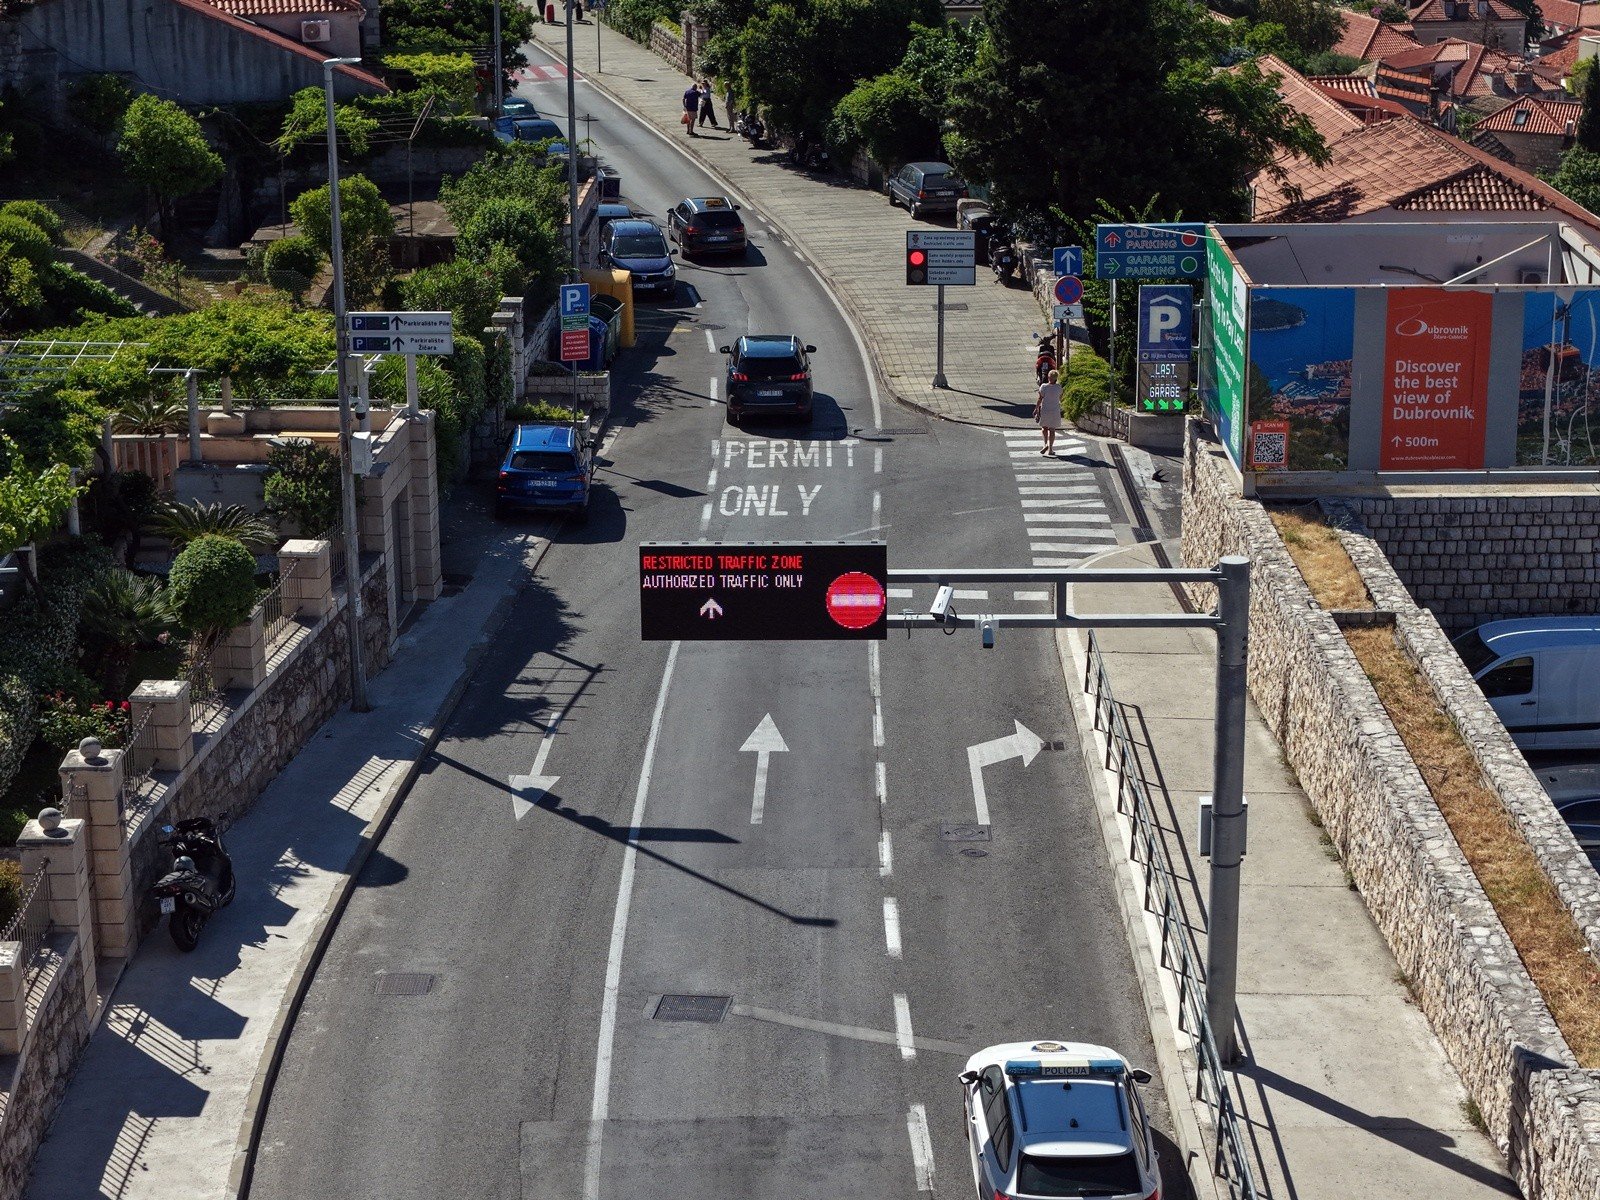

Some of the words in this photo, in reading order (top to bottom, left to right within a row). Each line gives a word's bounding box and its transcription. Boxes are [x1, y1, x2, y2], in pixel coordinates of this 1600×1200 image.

[1125, 229, 1149, 238] OLD
[1151, 228, 1179, 238] CITY
[1126, 240, 1178, 249] PARKING
[1126, 255, 1176, 265] GARAGE
[1125, 266, 1177, 276] PARKING
[567, 289, 581, 312] P
[1148, 305, 1182, 344] P
[1155, 363, 1176, 375] LAST
[1395, 360, 1462, 373] Discover
[1394, 375, 1420, 389] the
[1425, 375, 1459, 389] best
[1149, 386, 1180, 398] GARAGE
[1393, 391, 1430, 404] view
[1434, 390, 1452, 404] of
[1393, 405, 1475, 420] Dubrovnik
[1405, 436, 1439, 447] 500m
[723, 439, 860, 468] PERMIT
[719, 484, 823, 516] ONLY
[642, 555, 713, 570] RESTRICTED
[718, 555, 767, 570] TRAFFIC
[771, 555, 803, 570] ZONE
[642, 574, 715, 588] AUTHORIZED
[719, 574, 769, 588] TRAFFIC
[774, 574, 803, 588] ONLY
[1044, 1067, 1087, 1075] POLICIJA
